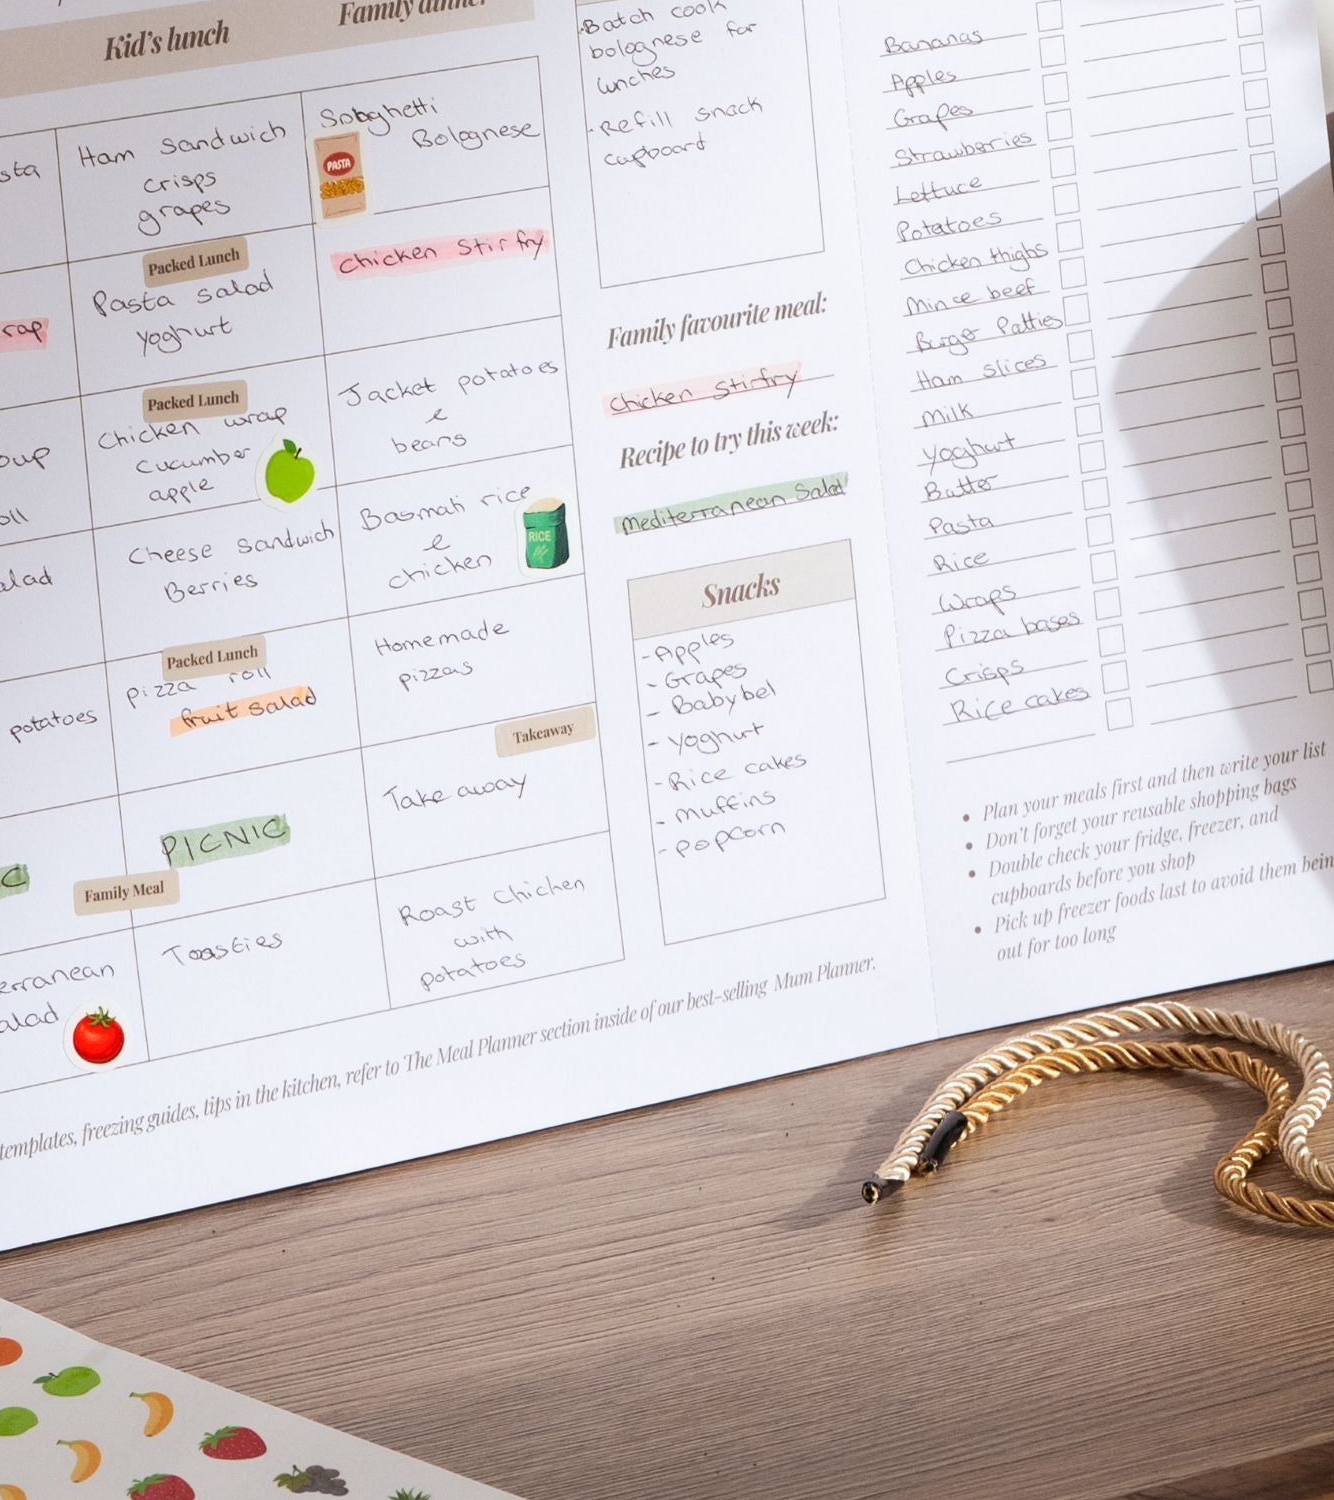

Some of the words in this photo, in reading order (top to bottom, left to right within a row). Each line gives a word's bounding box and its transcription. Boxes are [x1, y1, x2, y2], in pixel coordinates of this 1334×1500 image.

[166, 19, 230, 54] lunch
[326, 157, 352, 172] PASTA
[148, 254, 198, 278] Packed
[200, 247, 241, 270] Lunch
[607, 313, 677, 350] Family
[680, 302, 772, 339] favourite
[774, 291, 828, 322] meal:
[148, 393, 199, 413] Packed
[201, 388, 241, 407] Lunch
[619, 440, 688, 470] Recipe
[690, 436, 709, 456] to
[712, 430, 744, 457] try
[746, 420, 782, 447] this
[785, 411, 839, 440] week:
[528, 529, 552, 544] RICE
[701, 573, 782, 609] Snacks
[167, 649, 218, 672] Packed
[220, 645, 259, 665] Lunch
[512, 721, 575, 746] Takeaway
[984, 802, 1018, 821] Plan
[1022, 795, 1059, 818] your
[1064, 782, 1107, 805] meals
[1112, 776, 1143, 800] first
[1148, 768, 1176, 789] and
[1182, 765, 1214, 783] then
[1220, 755, 1259, 776] write
[1262, 749, 1299, 771] your
[1303, 741, 1326, 760] list
[986, 826, 1028, 849] Don't
[1034, 817, 1076, 844] forget
[1081, 812, 1118, 835] your
[1122, 796, 1185, 822] reusable
[1190, 784, 1260, 810] shopping
[1264, 777, 1296, 796] bags
[160, 816, 289, 868] PICNIC
[989, 851, 1043, 877] Double
[1048, 842, 1090, 866] check
[1094, 838, 1130, 860] your
[1135, 827, 1182, 852] fridge,
[1188, 817, 1243, 842] freezer,
[1250, 804, 1278, 826] and
[83, 883, 131, 907] Family
[133, 880, 165, 898] Meal
[773, 970, 813, 992] Mum
[774, 971, 812, 991] best-selling
[816, 956, 876, 984] Planner.
[658, 999, 684, 1016] of
[687, 980, 768, 1010] our
[594, 1007, 637, 1031] section
[640, 1001, 657, 1023] inside
[540, 1019, 590, 1042] Planner
[437, 1040, 473, 1065] The
[478, 1031, 537, 1056] Meal
[346, 1063, 382, 1086] kitchen,
[385, 1060, 399, 1076] refer
[404, 1052, 433, 1072] to
[256, 1085, 278, 1104] in
[282, 1074, 341, 1099] the
[204, 1096, 231, 1118] guides,
[235, 1090, 252, 1109] tips
[146, 1103, 199, 1133] freezing
[82, 1115, 145, 1147] templates,
[0, 1131, 77, 1160] recipe
